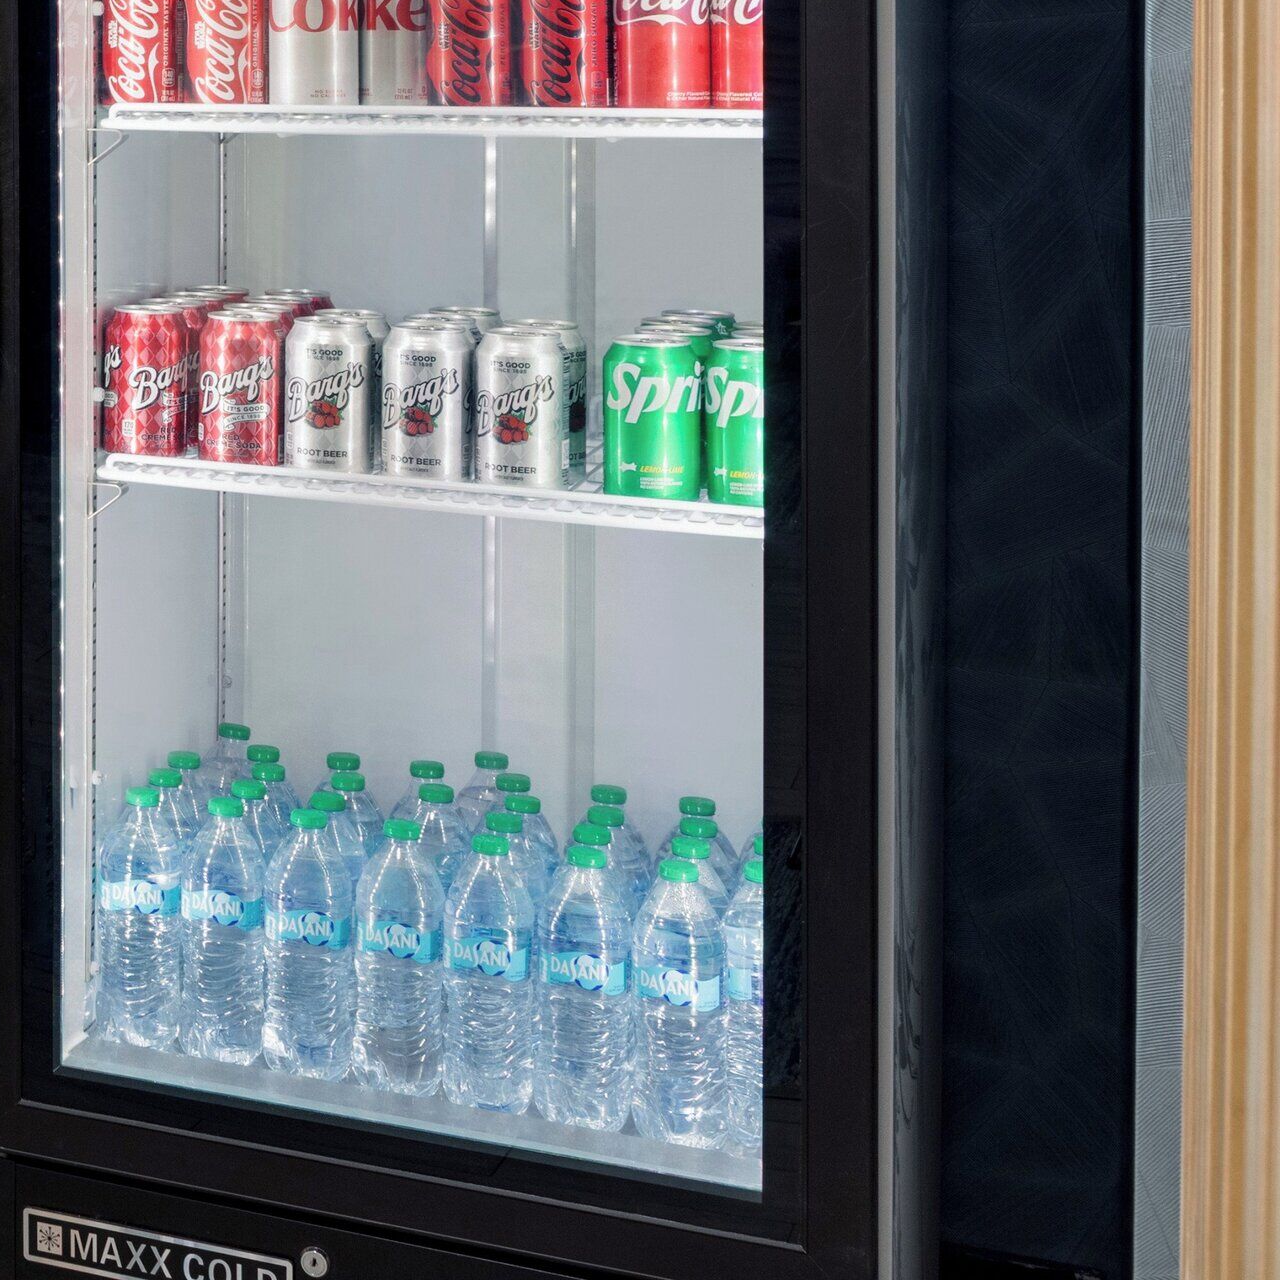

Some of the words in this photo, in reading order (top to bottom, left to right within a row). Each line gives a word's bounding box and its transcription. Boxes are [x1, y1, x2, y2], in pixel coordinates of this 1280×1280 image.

[200, 355, 275, 415] Barq's
[289, 361, 365, 422] Barq's
[384, 367, 460, 429] Barq's
[477, 374, 555, 436] Barq's
[297, 447, 320, 458] ROOT
[323, 449, 348, 458] BEER
[417, 458, 441, 466] BEER
[485, 463, 508, 472] ROOT
[511, 466, 537, 475] BEER
[112, 880, 165, 912] DASANI
[192, 893, 243, 921] DASANI
[278, 913, 333, 943] DASANI
[365, 925, 420, 955] DASANI
[453, 938, 510, 972] DASANI
[549, 954, 609, 986] DASANI
[640, 970, 699, 1001] DASANI
[69, 1228, 172, 1279] MAXX
